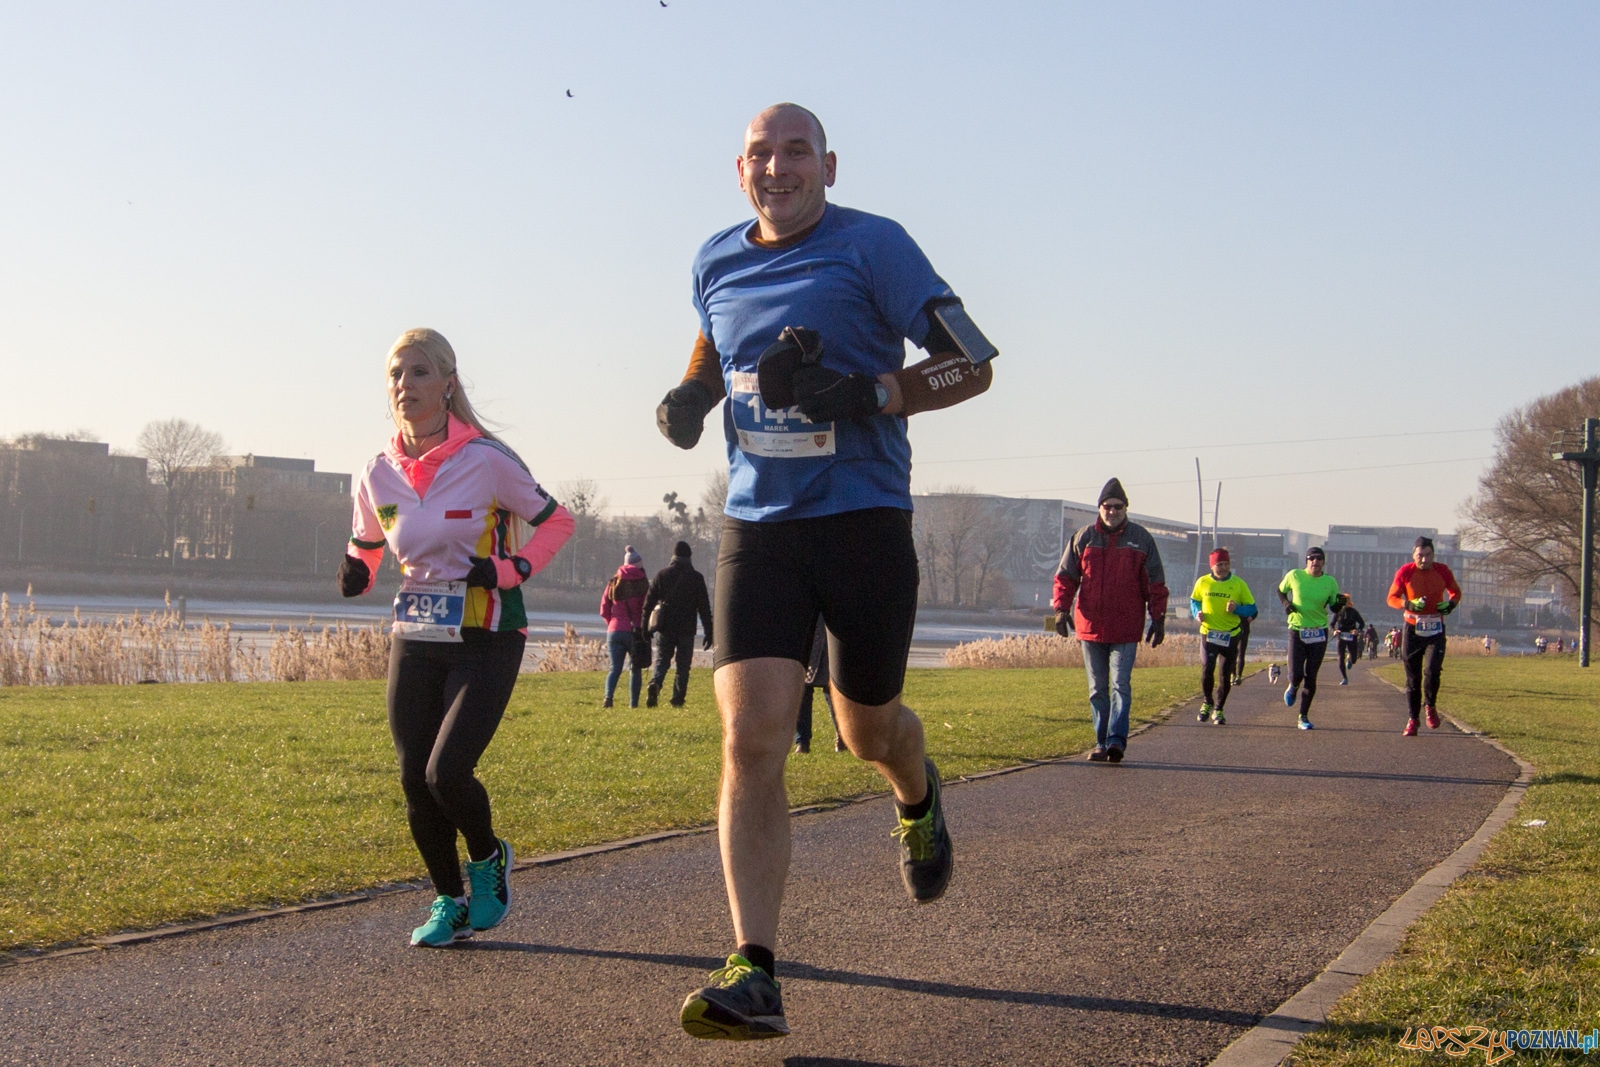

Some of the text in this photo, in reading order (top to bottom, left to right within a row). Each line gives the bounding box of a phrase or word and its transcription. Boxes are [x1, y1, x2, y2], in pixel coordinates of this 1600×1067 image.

[928, 368, 963, 390] 2016
[406, 594, 449, 618] 294
[1421, 621, 1437, 630] 196
